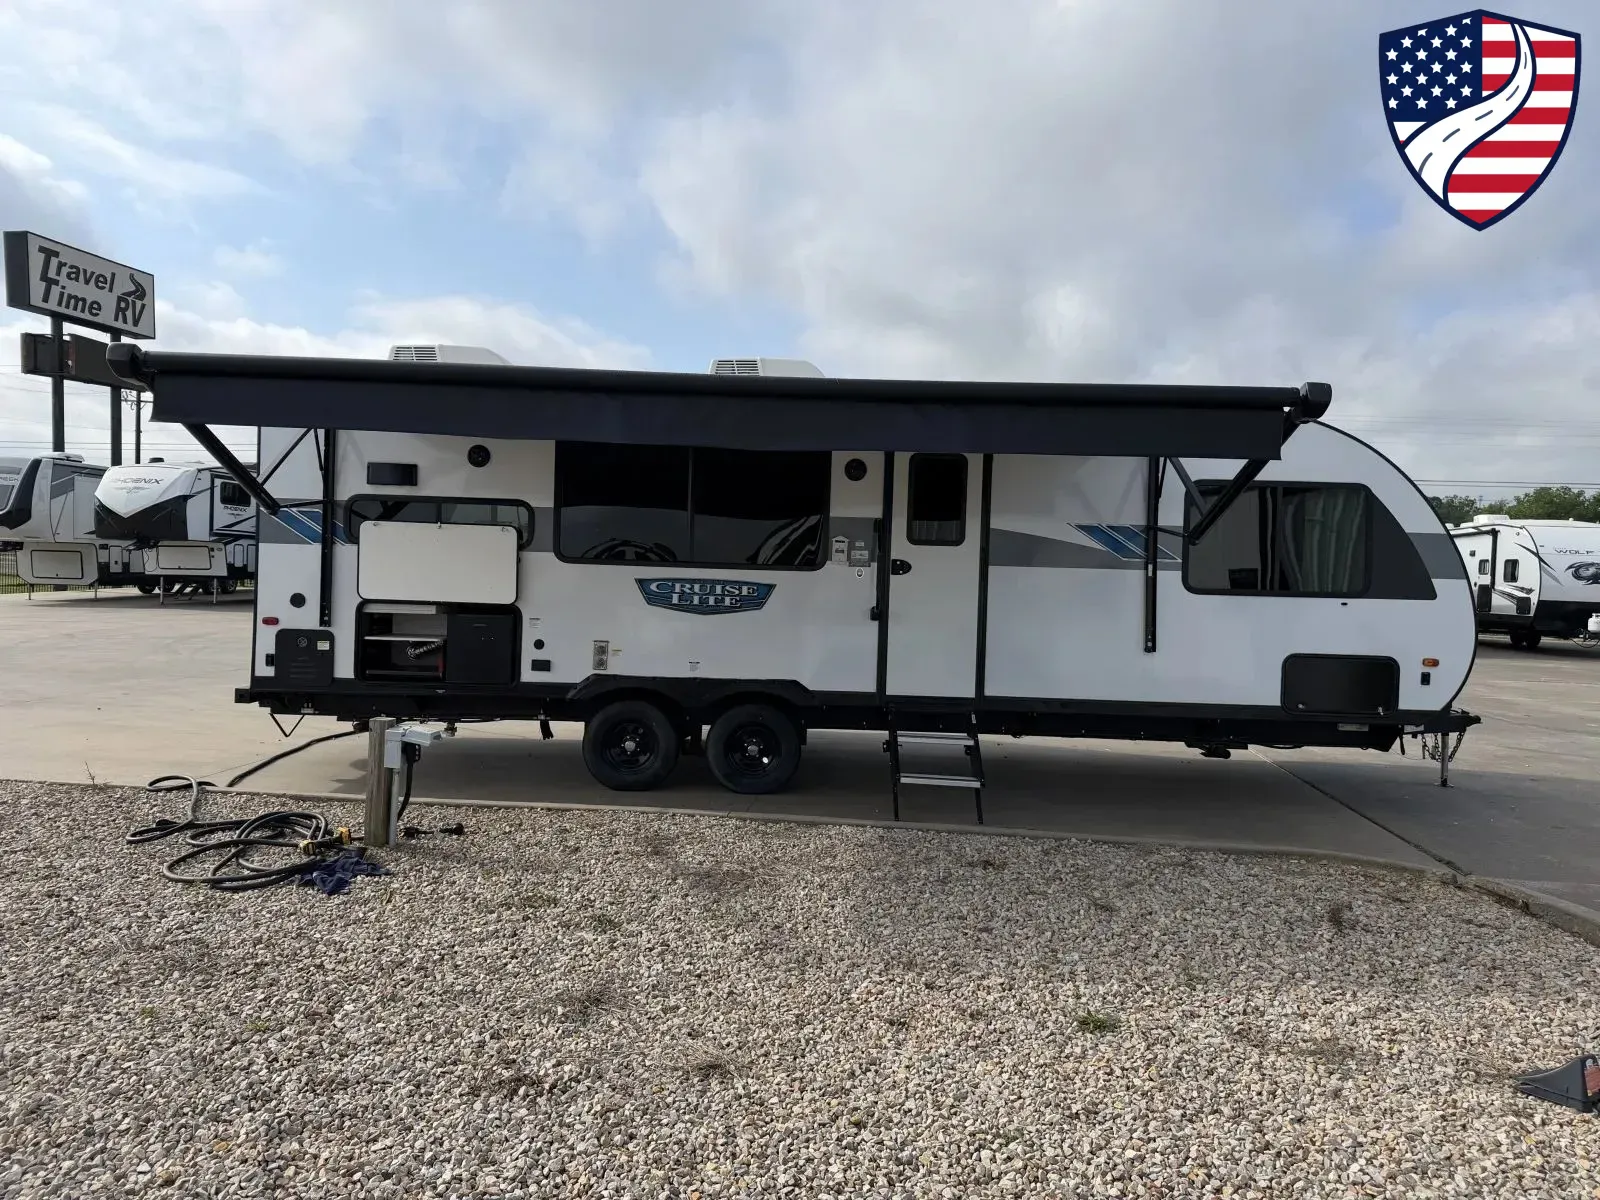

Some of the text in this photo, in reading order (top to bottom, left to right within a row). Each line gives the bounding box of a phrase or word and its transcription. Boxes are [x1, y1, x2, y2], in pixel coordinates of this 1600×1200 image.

[37, 245, 116, 293] Travel
[39, 277, 147, 327] Time RV
[111, 477, 164, 485] PHOENIX
[223, 505, 248, 513] PHOENIX
[650, 581, 758, 596] CRUISE
[671, 593, 741, 607] LITE
